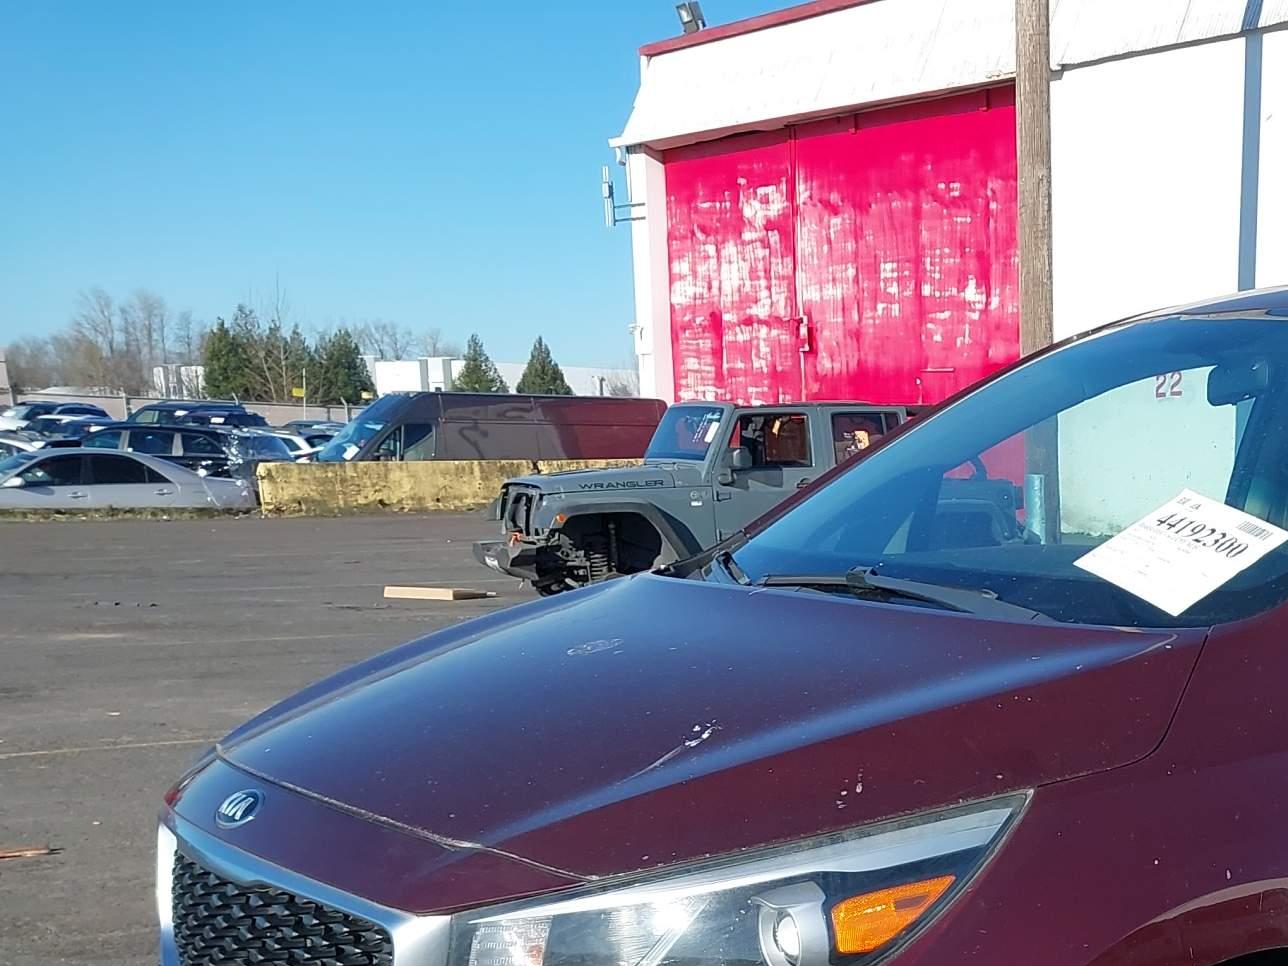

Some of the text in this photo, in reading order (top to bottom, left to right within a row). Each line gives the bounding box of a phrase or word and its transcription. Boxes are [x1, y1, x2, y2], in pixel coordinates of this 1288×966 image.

[1155, 371, 1183, 398] 22
[578, 479, 665, 490] WRANGLER
[1155, 512, 1249, 559] 44192300
